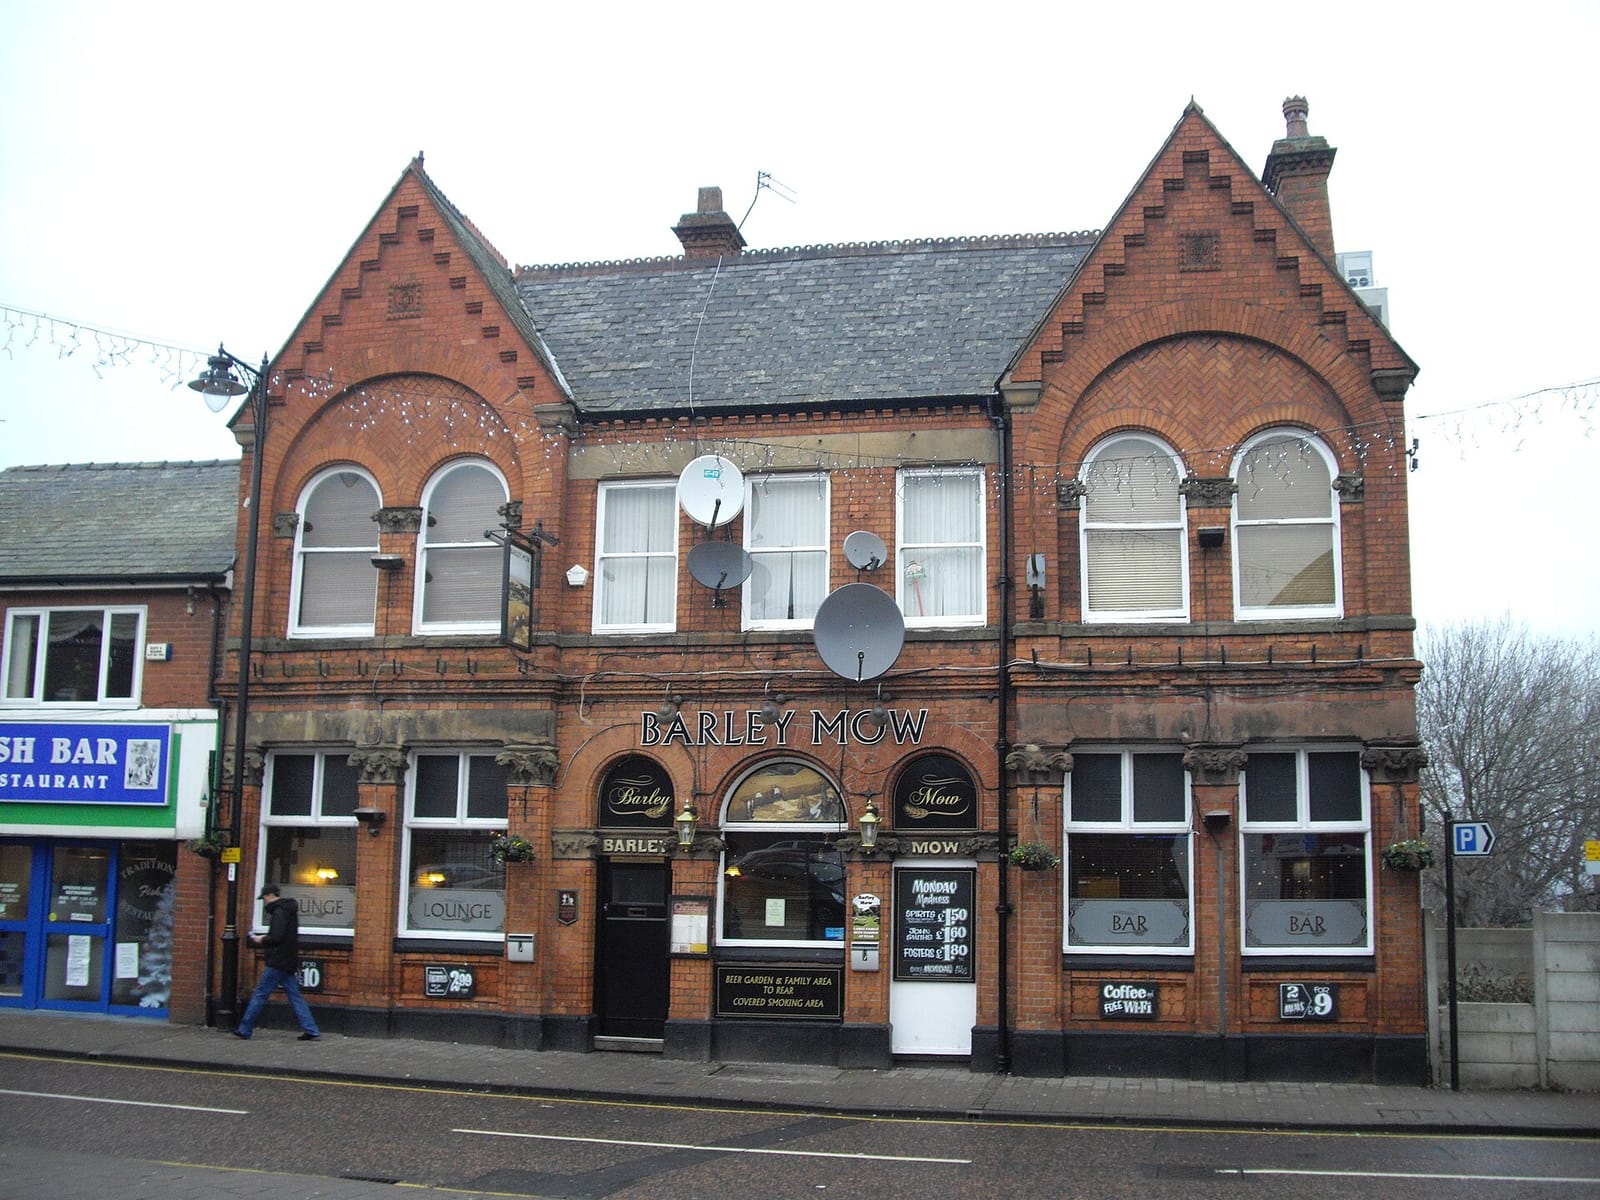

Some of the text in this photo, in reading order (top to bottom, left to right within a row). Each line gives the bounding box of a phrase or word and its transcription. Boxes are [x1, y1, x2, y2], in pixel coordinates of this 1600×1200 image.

[640, 708, 928, 746] BARLEY MOW
[51, 737, 118, 765] BAR
[609, 786, 671, 812] Barley
[909, 786, 961, 806] Mow
[1460, 829, 1474, 849] P
[911, 841, 959, 854] MOW
[121, 860, 176, 879] TRADITION
[912, 879, 957, 894] MONDAY
[300, 900, 343, 914] UNGE
[424, 902, 492, 919] LOUNGE
[1112, 915, 1147, 931] BAR
[1290, 916, 1326, 932] BAR
[725, 975, 742, 984] BEER
[744, 976, 773, 984] GARDEN
[784, 976, 811, 985] FAMILY
[813, 977, 832, 986] AREA
[763, 985, 794, 994] TO REAR
[1103, 984, 1147, 999] Coffee
[1287, 985, 1299, 999] 2
[733, 997, 824, 1008] COVERED SMOKING AREA
